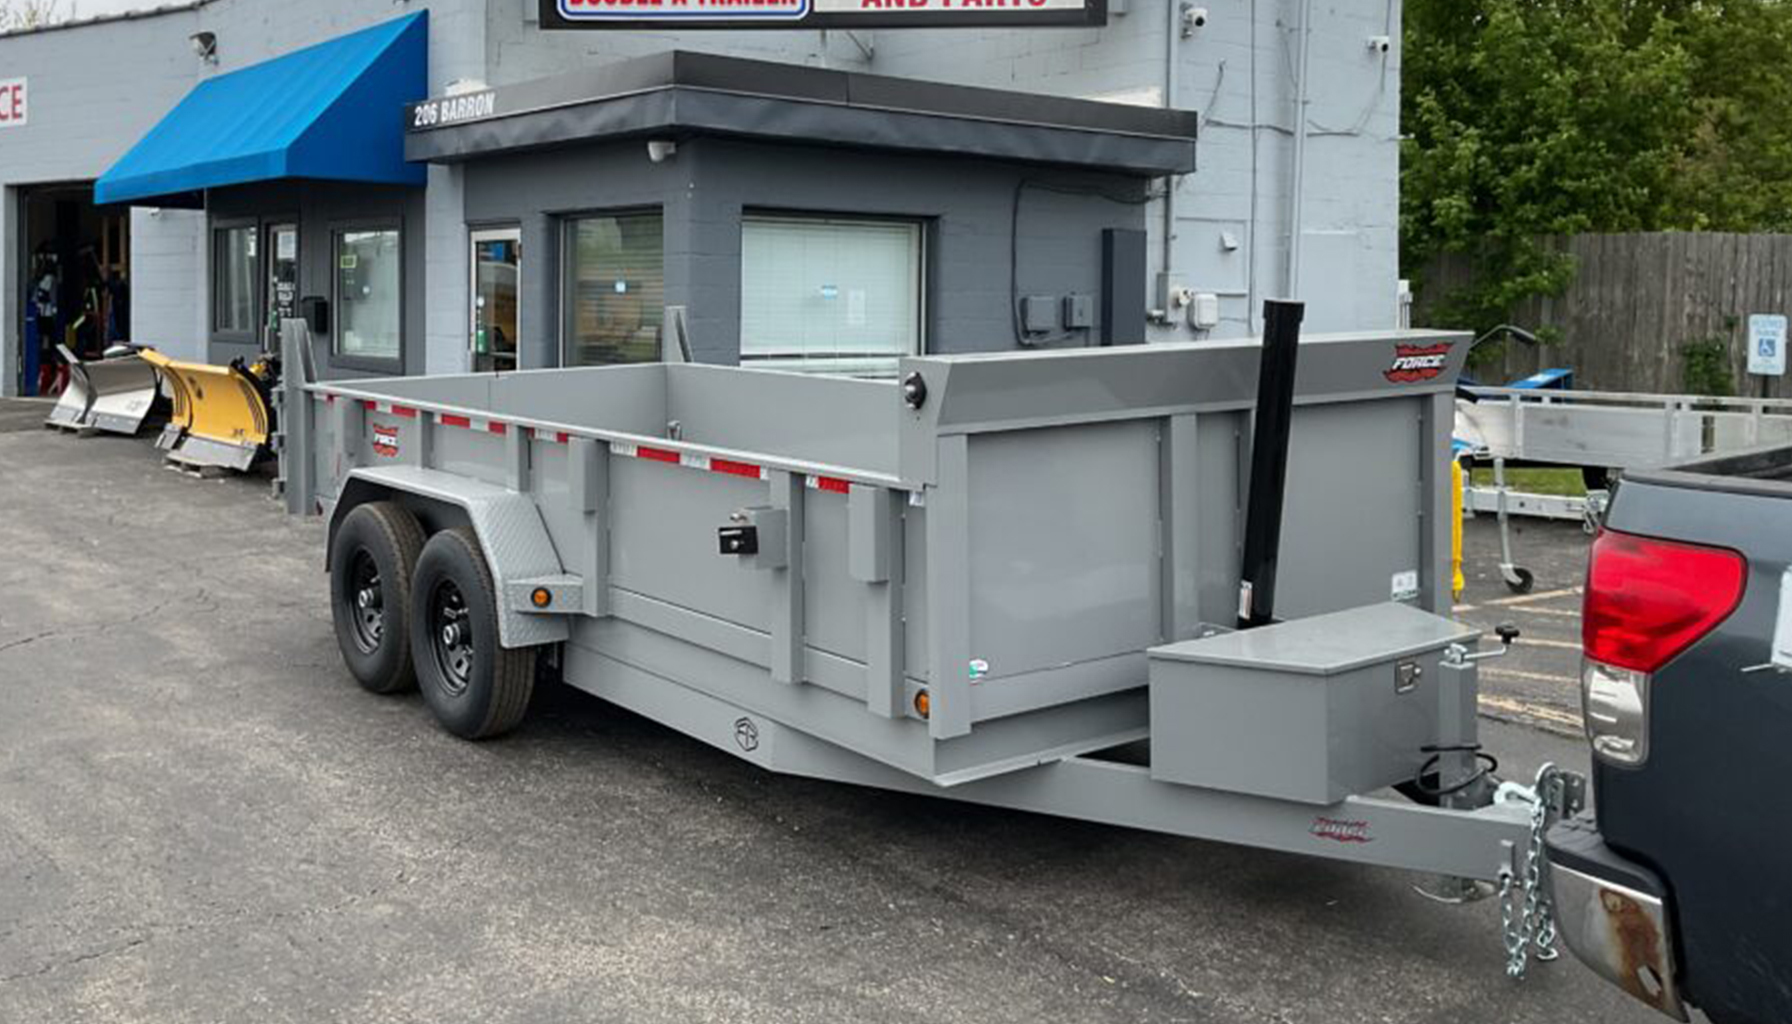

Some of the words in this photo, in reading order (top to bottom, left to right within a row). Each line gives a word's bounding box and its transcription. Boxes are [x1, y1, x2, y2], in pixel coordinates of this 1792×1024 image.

[414, 103, 438, 127] 206
[441, 92, 496, 123] BARRON
[1392, 354, 1446, 370] FORCE
